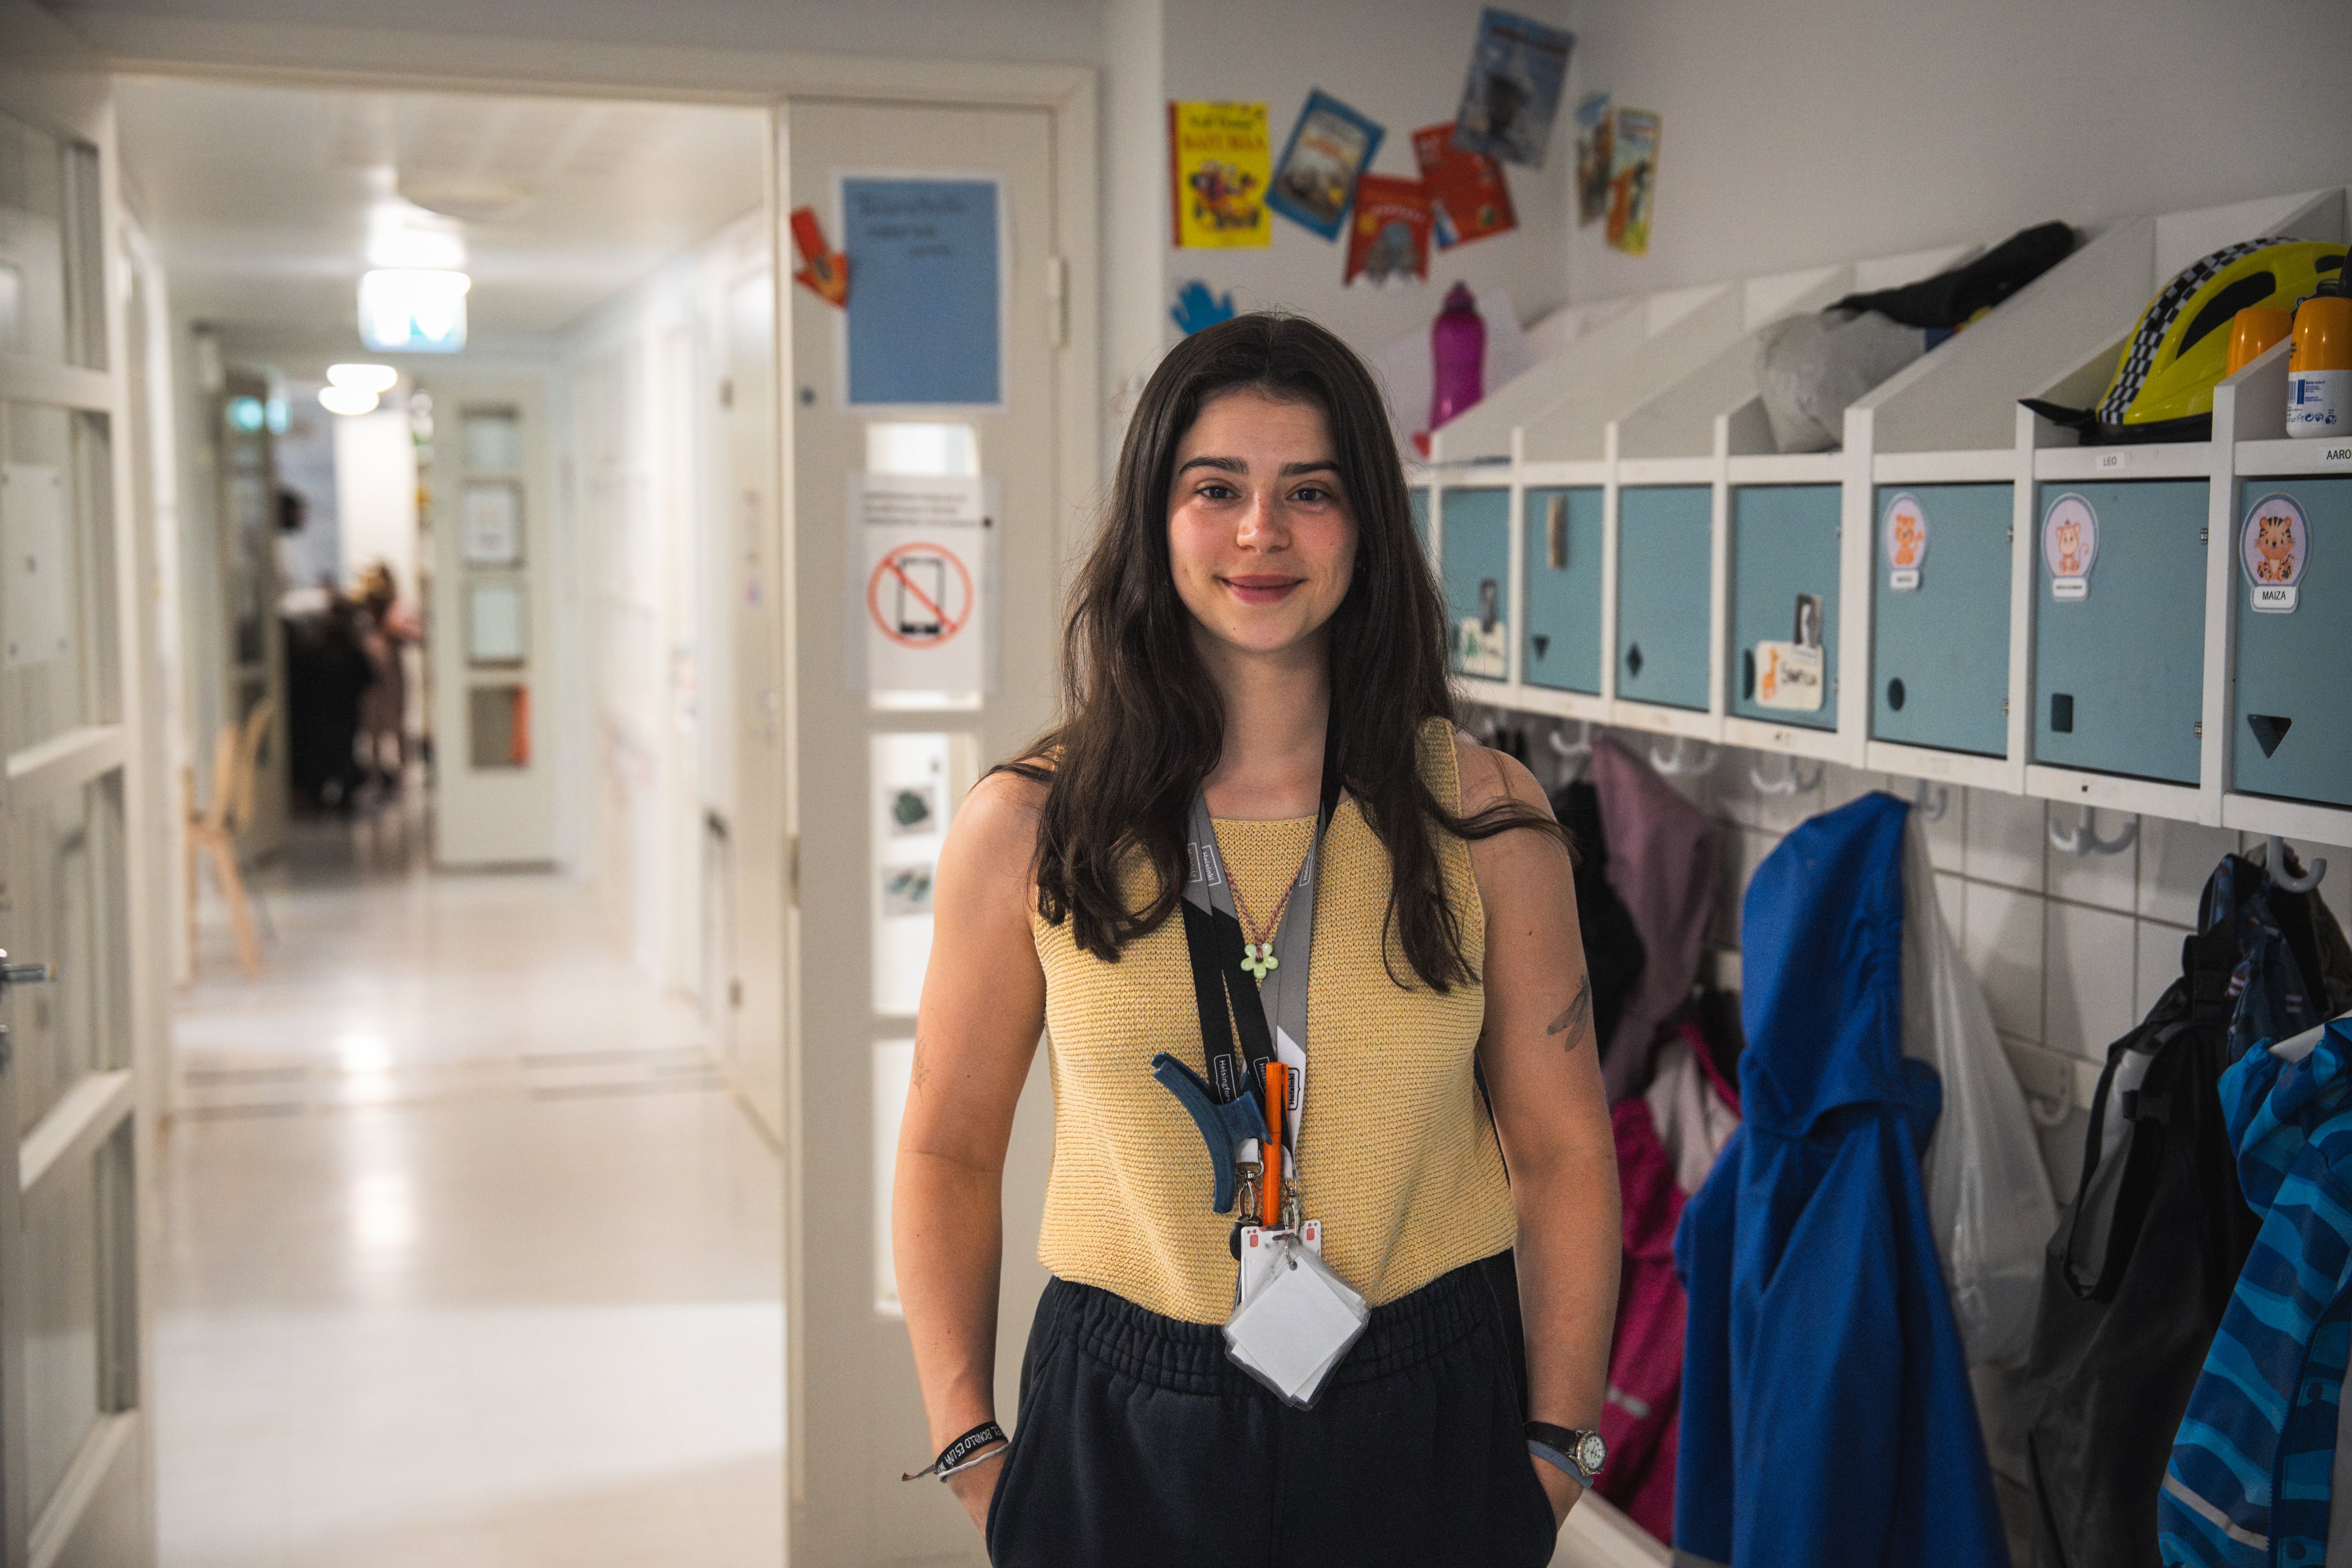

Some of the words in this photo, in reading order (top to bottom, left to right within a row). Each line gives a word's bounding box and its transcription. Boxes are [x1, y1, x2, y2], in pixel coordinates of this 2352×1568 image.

[2103, 455, 2117, 466] LEO
[2326, 449, 2352, 460] AARO
[2262, 590, 2286, 600] MAIZA
[1202, 852, 1215, 881] Helsinki
[1219, 1060, 1231, 1102] Helsingfors
[955, 1442, 965, 1457] ES
